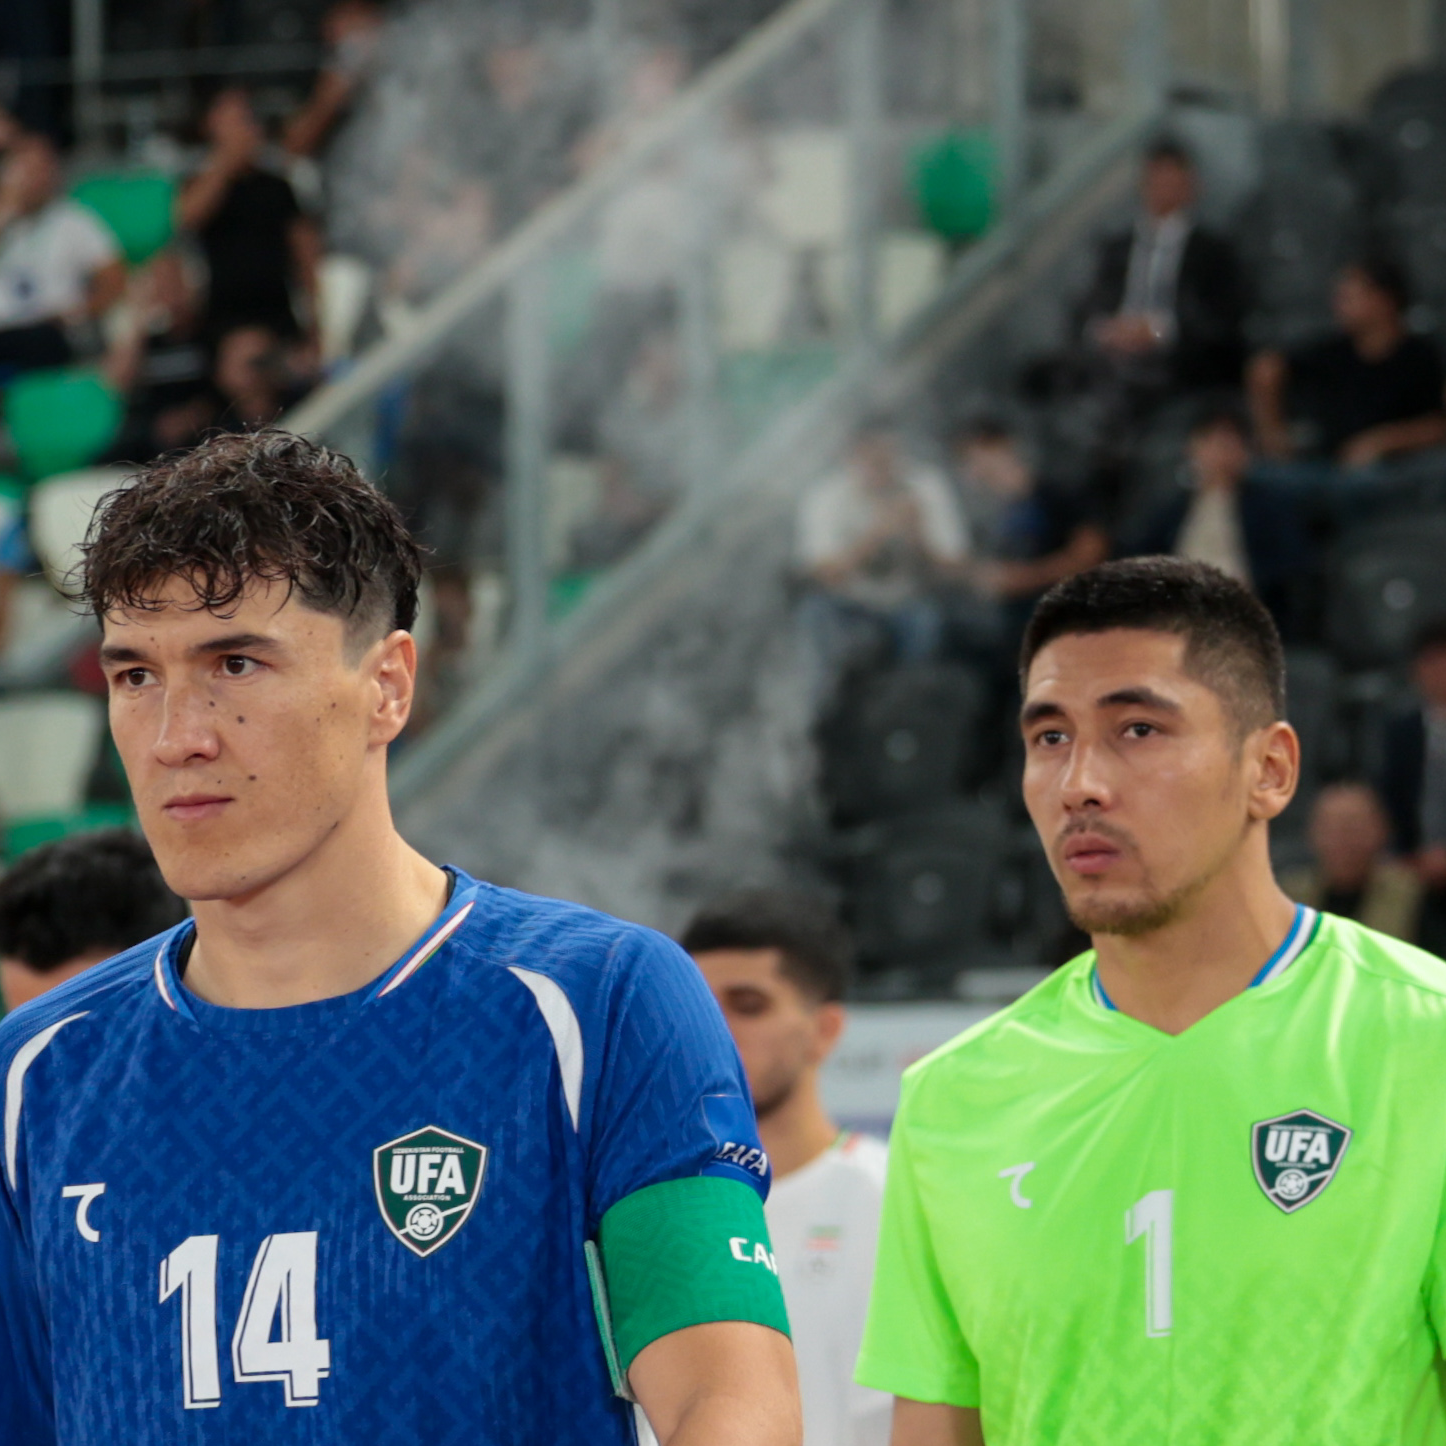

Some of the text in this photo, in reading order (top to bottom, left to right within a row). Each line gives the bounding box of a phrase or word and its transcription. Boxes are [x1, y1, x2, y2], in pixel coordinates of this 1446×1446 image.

[390, 1153, 467, 1195] UFA
[1264, 1129, 1331, 1165] UFA
[1124, 1189, 1173, 1338] 1
[159, 1231, 330, 1409] 14
